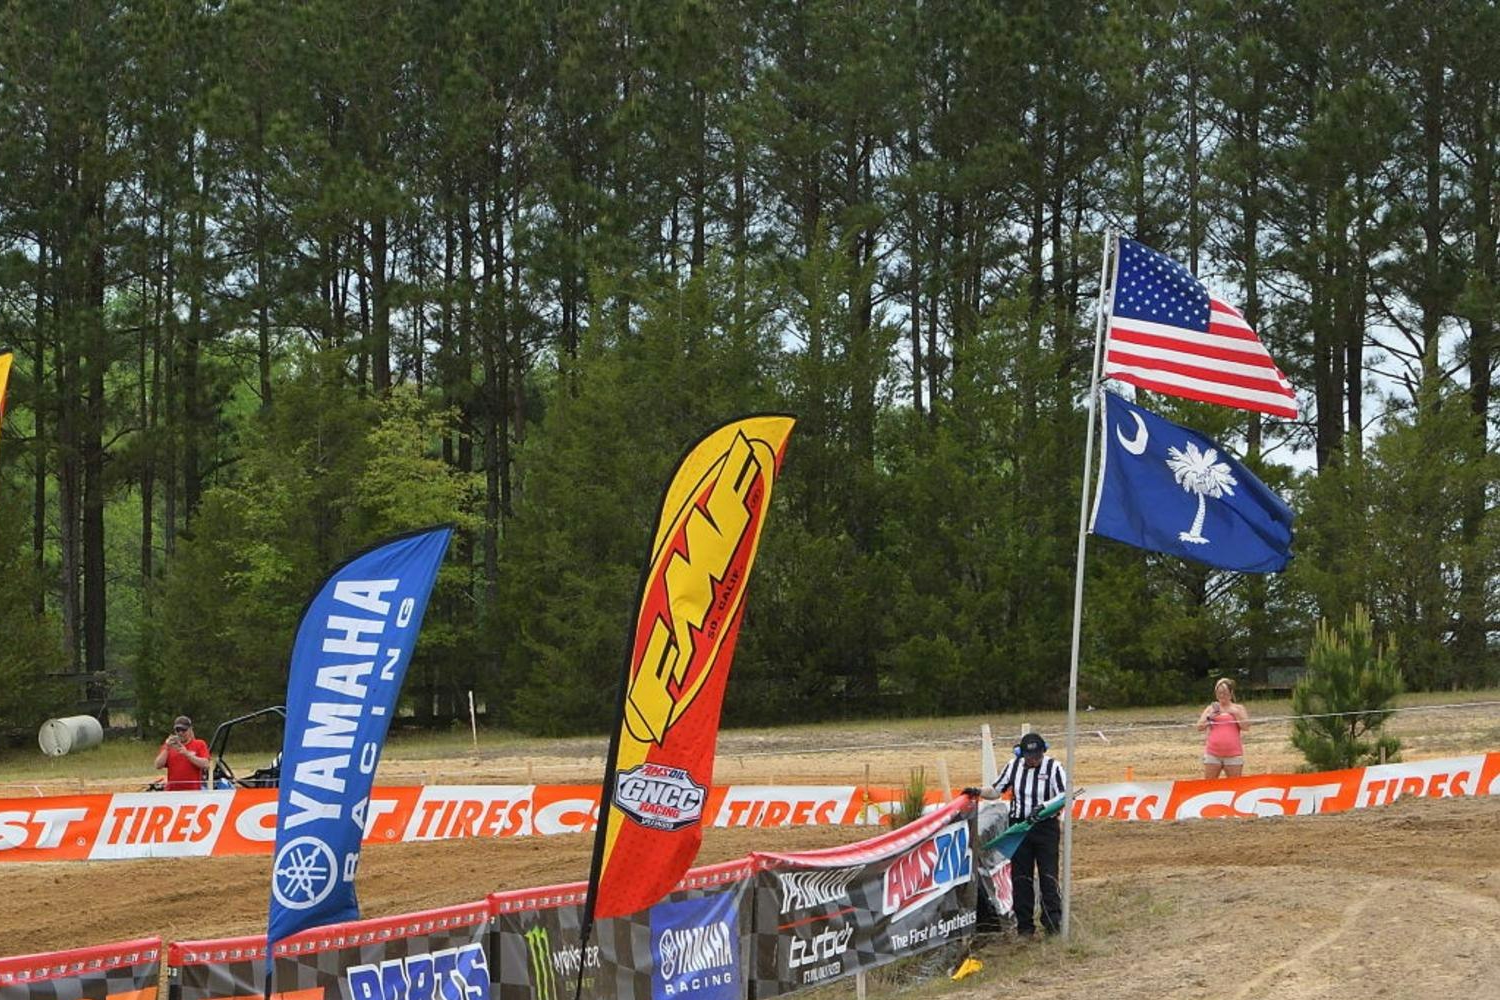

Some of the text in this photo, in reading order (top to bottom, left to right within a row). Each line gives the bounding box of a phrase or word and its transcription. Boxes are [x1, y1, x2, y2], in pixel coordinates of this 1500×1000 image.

[629, 428, 762, 747] FMF
[284, 578, 399, 831] YAMAHA
[343, 596, 415, 882] RACING
[619, 778, 700, 812] GNCC
[1071, 795, 1158, 821] IRES
[108, 804, 219, 845] TIRES
[415, 800, 526, 838] TIRES
[886, 827, 972, 910] AMSOIL
[553, 944, 601, 976] MONSER
[891, 934, 909, 950] The
[665, 972, 733, 996] RACING
